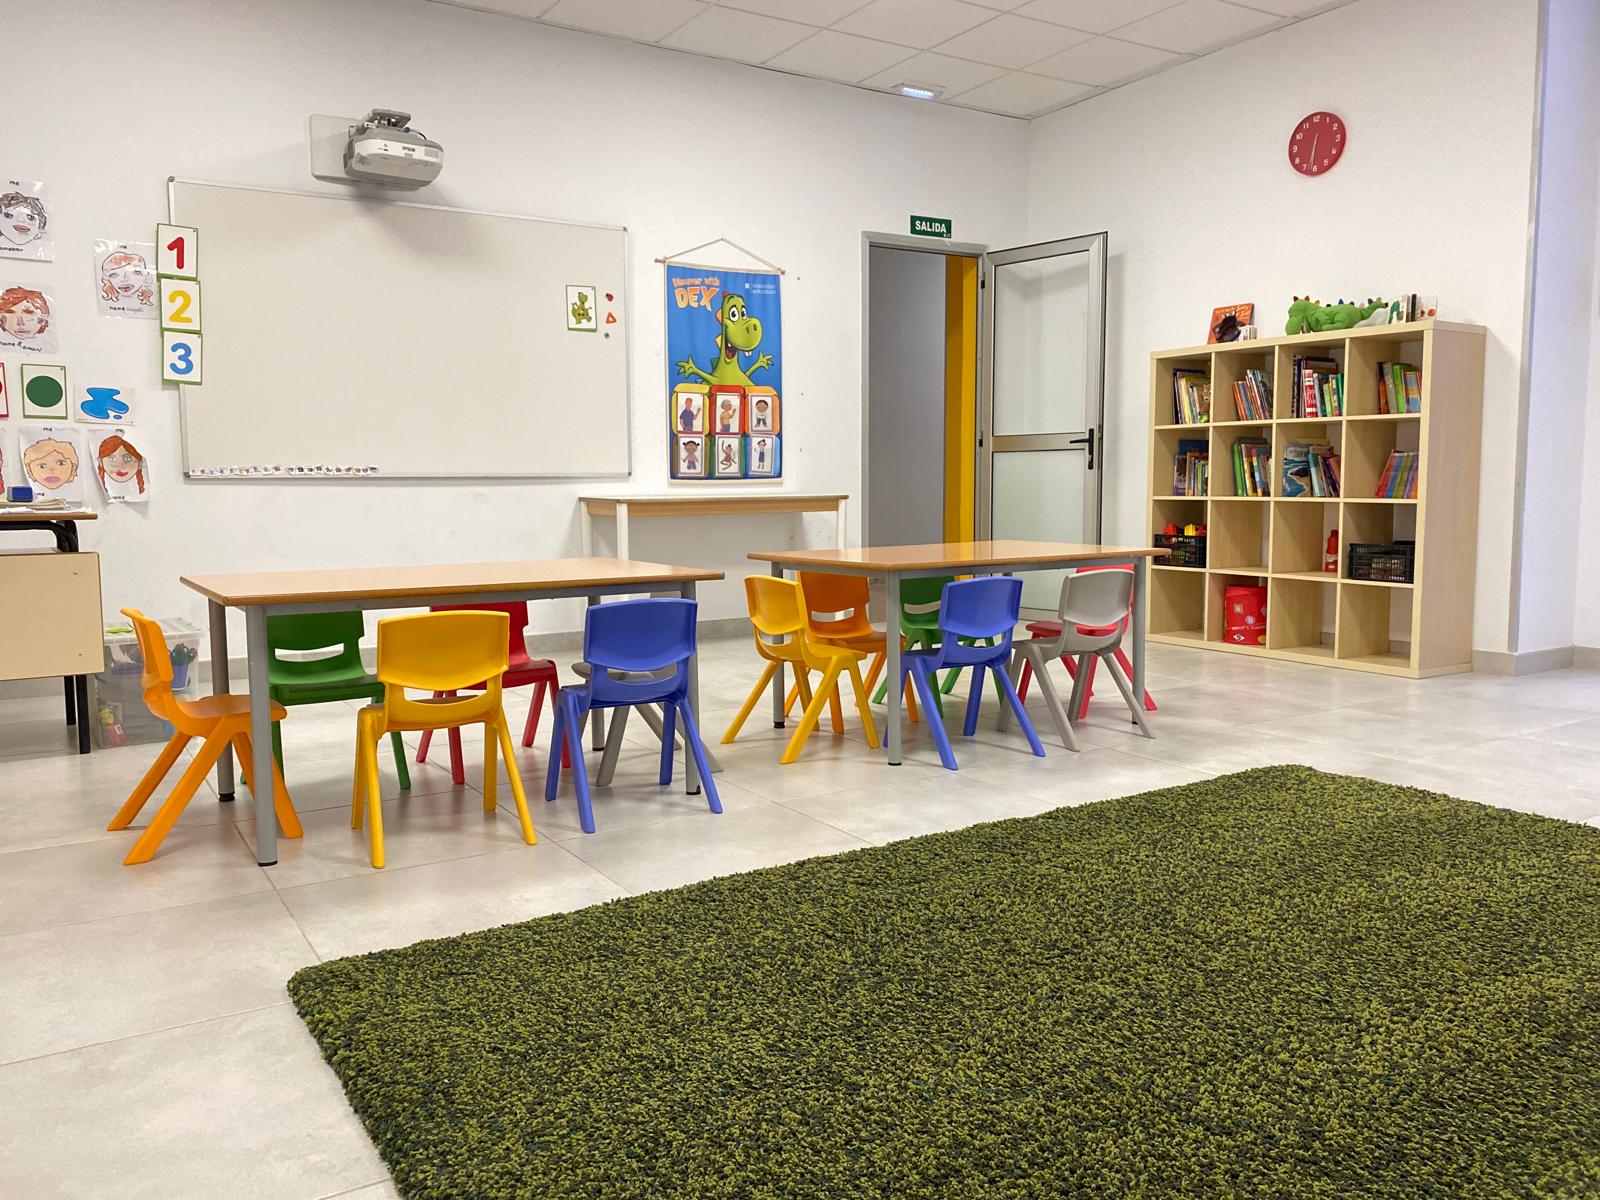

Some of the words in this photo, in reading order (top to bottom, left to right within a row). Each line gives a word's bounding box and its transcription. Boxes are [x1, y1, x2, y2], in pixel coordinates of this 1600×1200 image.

[915, 220, 947, 233] SALIDA
[166, 236, 185, 270] 1
[168, 290, 193, 323] 2
[674, 286, 720, 312] DEX
[169, 342, 194, 375] 3
